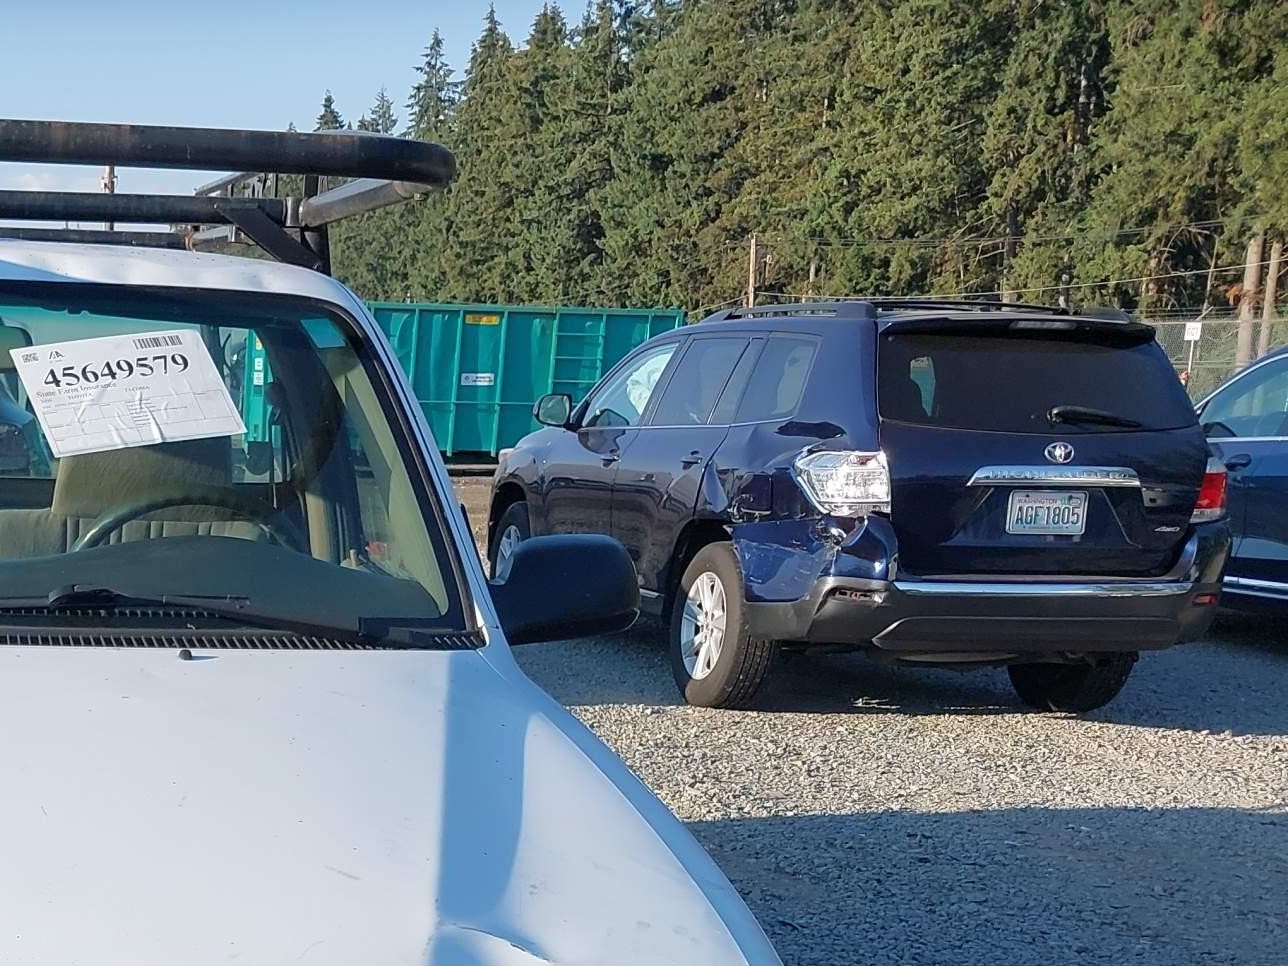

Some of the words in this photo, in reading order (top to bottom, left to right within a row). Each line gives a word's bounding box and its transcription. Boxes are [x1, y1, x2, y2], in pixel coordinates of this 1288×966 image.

[43, 353, 189, 388] 45649579
[58, 388, 79, 396] Farm
[1015, 505, 1081, 526] AGF1805
